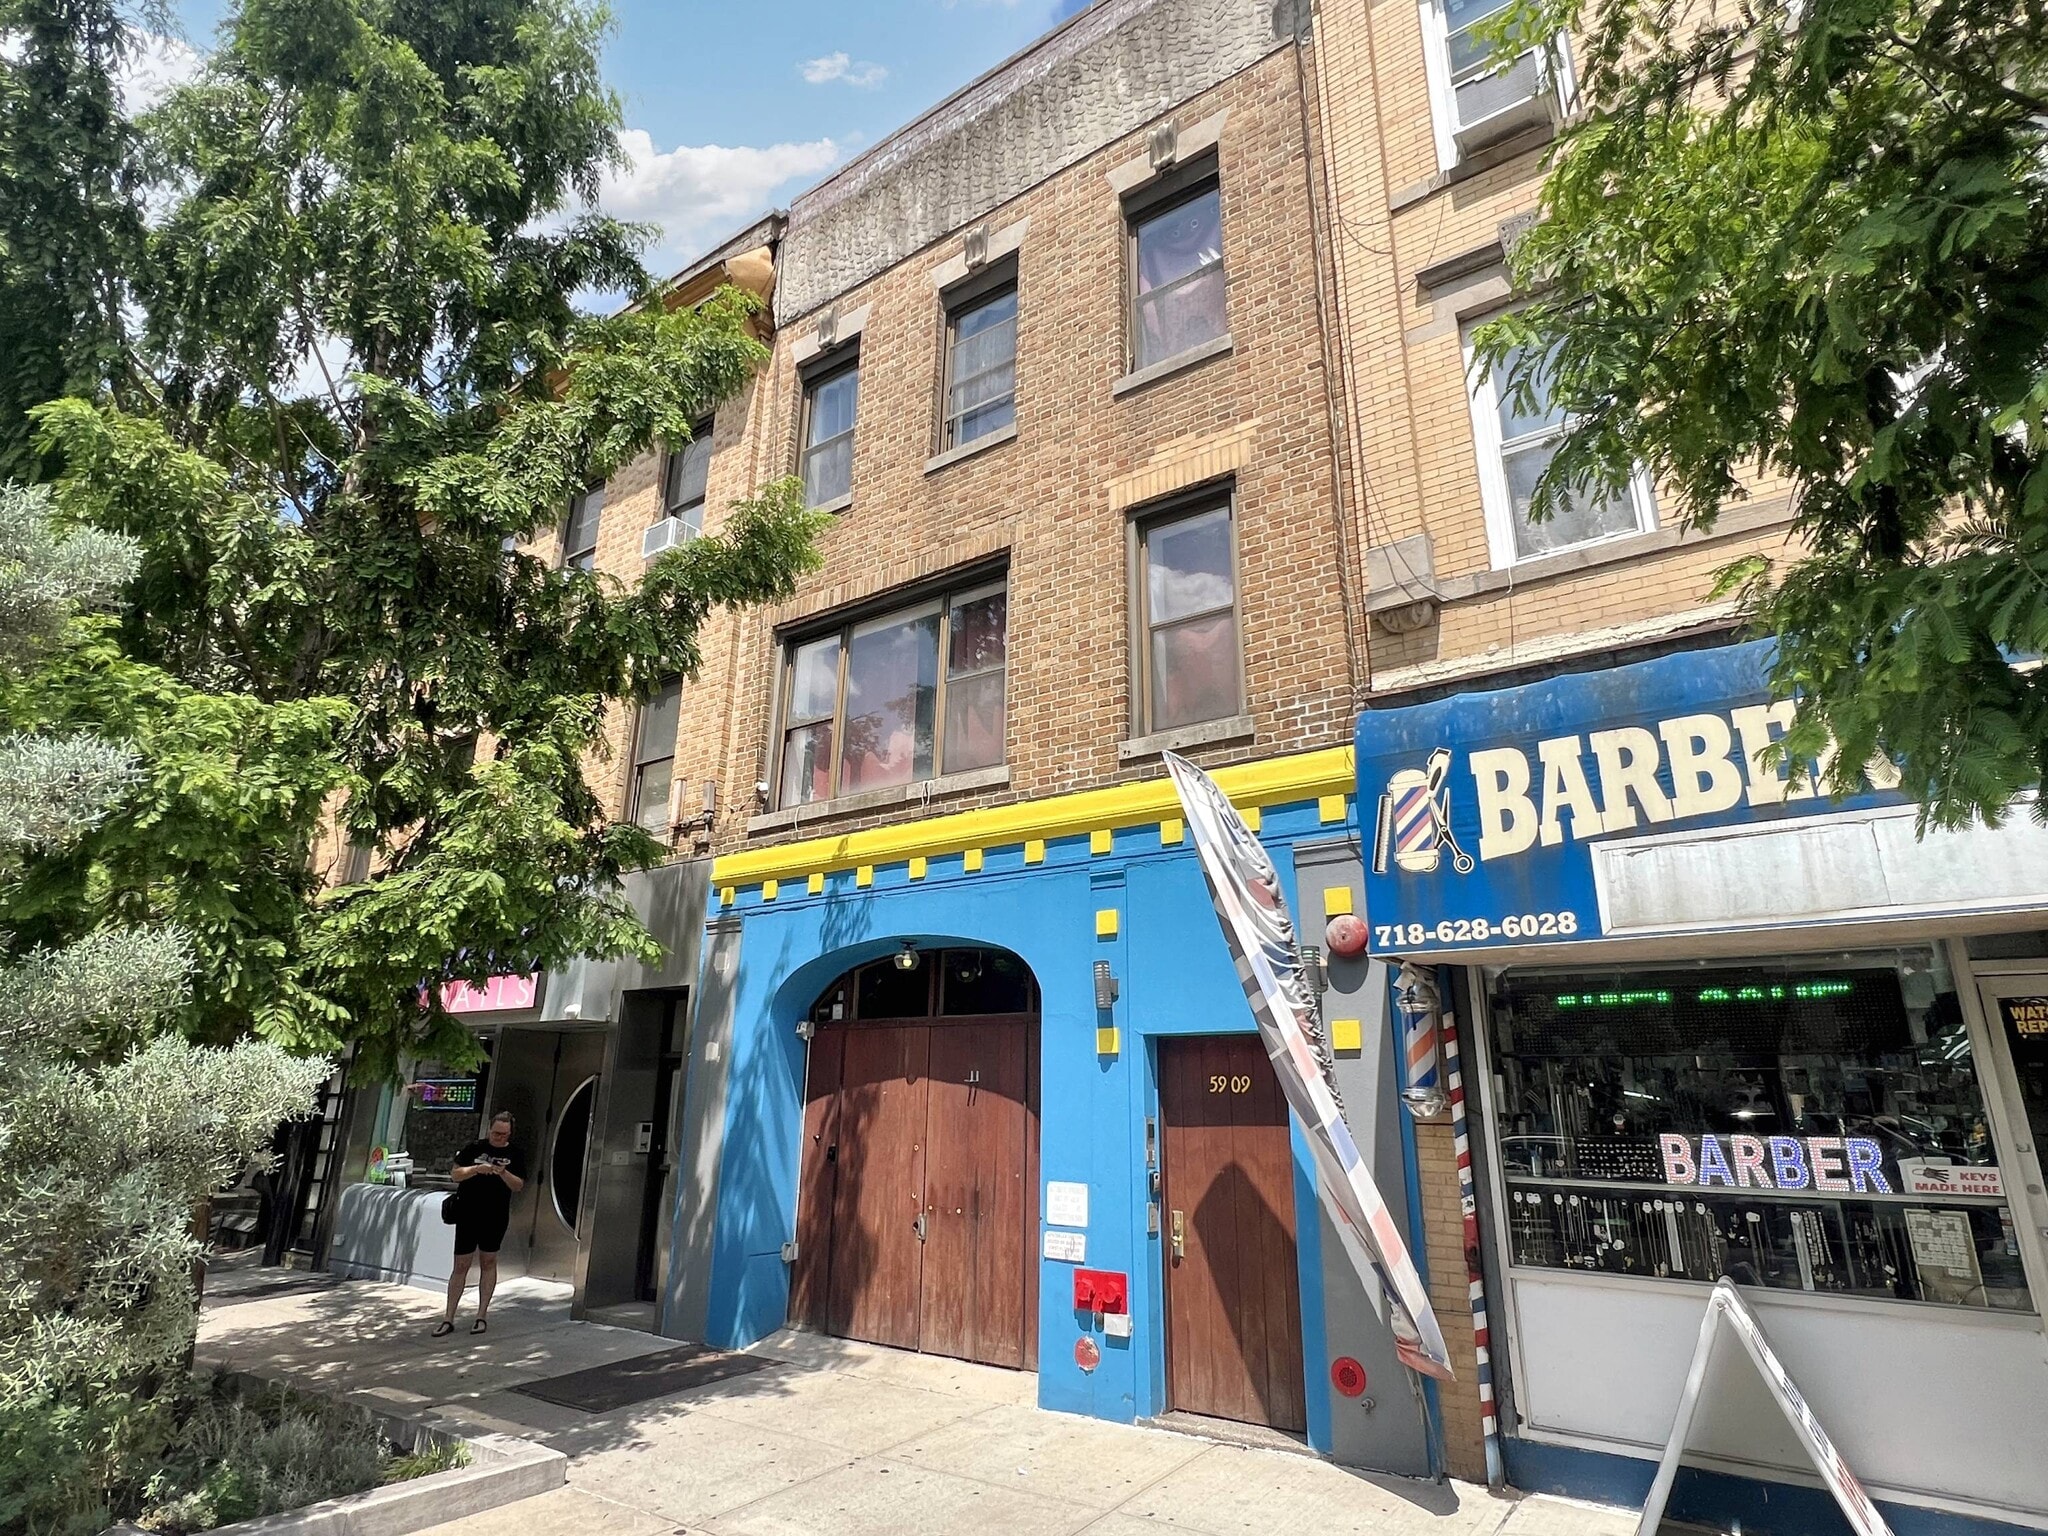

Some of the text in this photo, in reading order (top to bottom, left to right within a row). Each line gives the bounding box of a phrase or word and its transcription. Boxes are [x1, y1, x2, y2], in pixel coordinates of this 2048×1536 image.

[1375, 911, 1578, 947] 718-628-6028
[1659, 1133, 1893, 1194] BARBER
[1915, 1182, 2000, 1194] MADE HERE
[1960, 1172, 1997, 1182] KEYS
